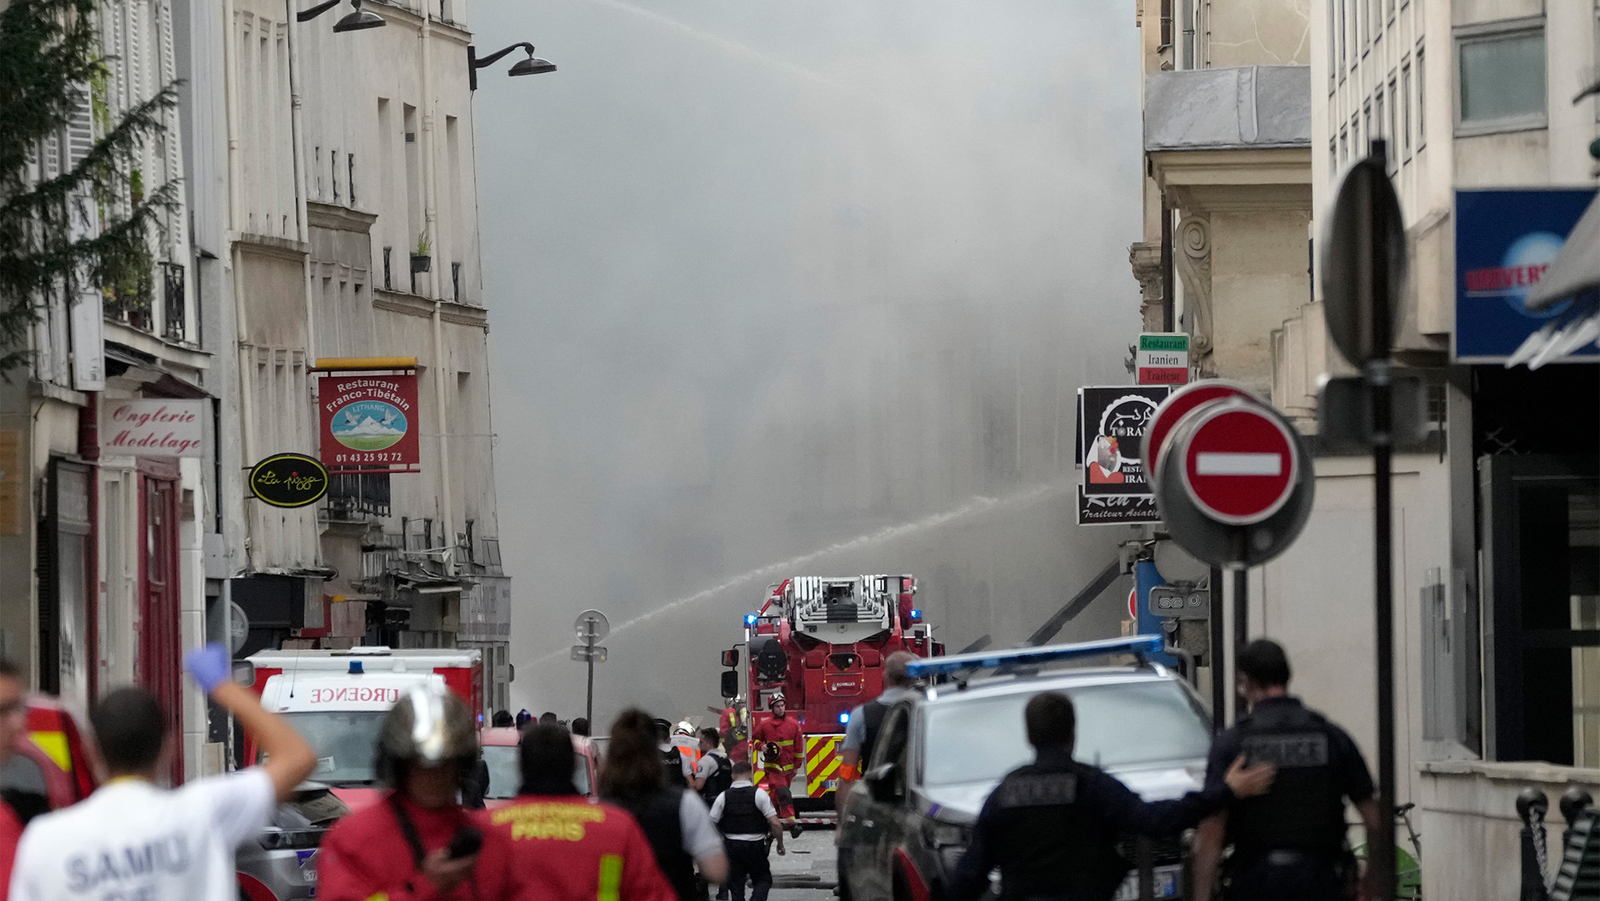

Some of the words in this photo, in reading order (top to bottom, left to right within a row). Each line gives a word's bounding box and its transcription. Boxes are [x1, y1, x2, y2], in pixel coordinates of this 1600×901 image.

[1141, 337, 1186, 349] Restaurant
[1148, 354, 1179, 365] Iranien
[1146, 370, 1180, 381] Traiteur
[337, 379, 399, 392] Restaurant
[326, 388, 410, 413] Franco-Tibétain
[352, 404, 386, 412] LITHANG
[112, 405, 195, 427] Onglerie
[106, 430, 201, 454] Modelage
[336, 454, 346, 462] 01
[350, 454, 360, 462] 43
[364, 453, 375, 462] 25
[377, 453, 388, 462] 92
[391, 453, 402, 461] 72
[258, 470, 280, 485] La
[283, 472, 322, 490] pizza
[1082, 509, 1123, 518] Traiteur
[511, 820, 586, 841] PARIS
